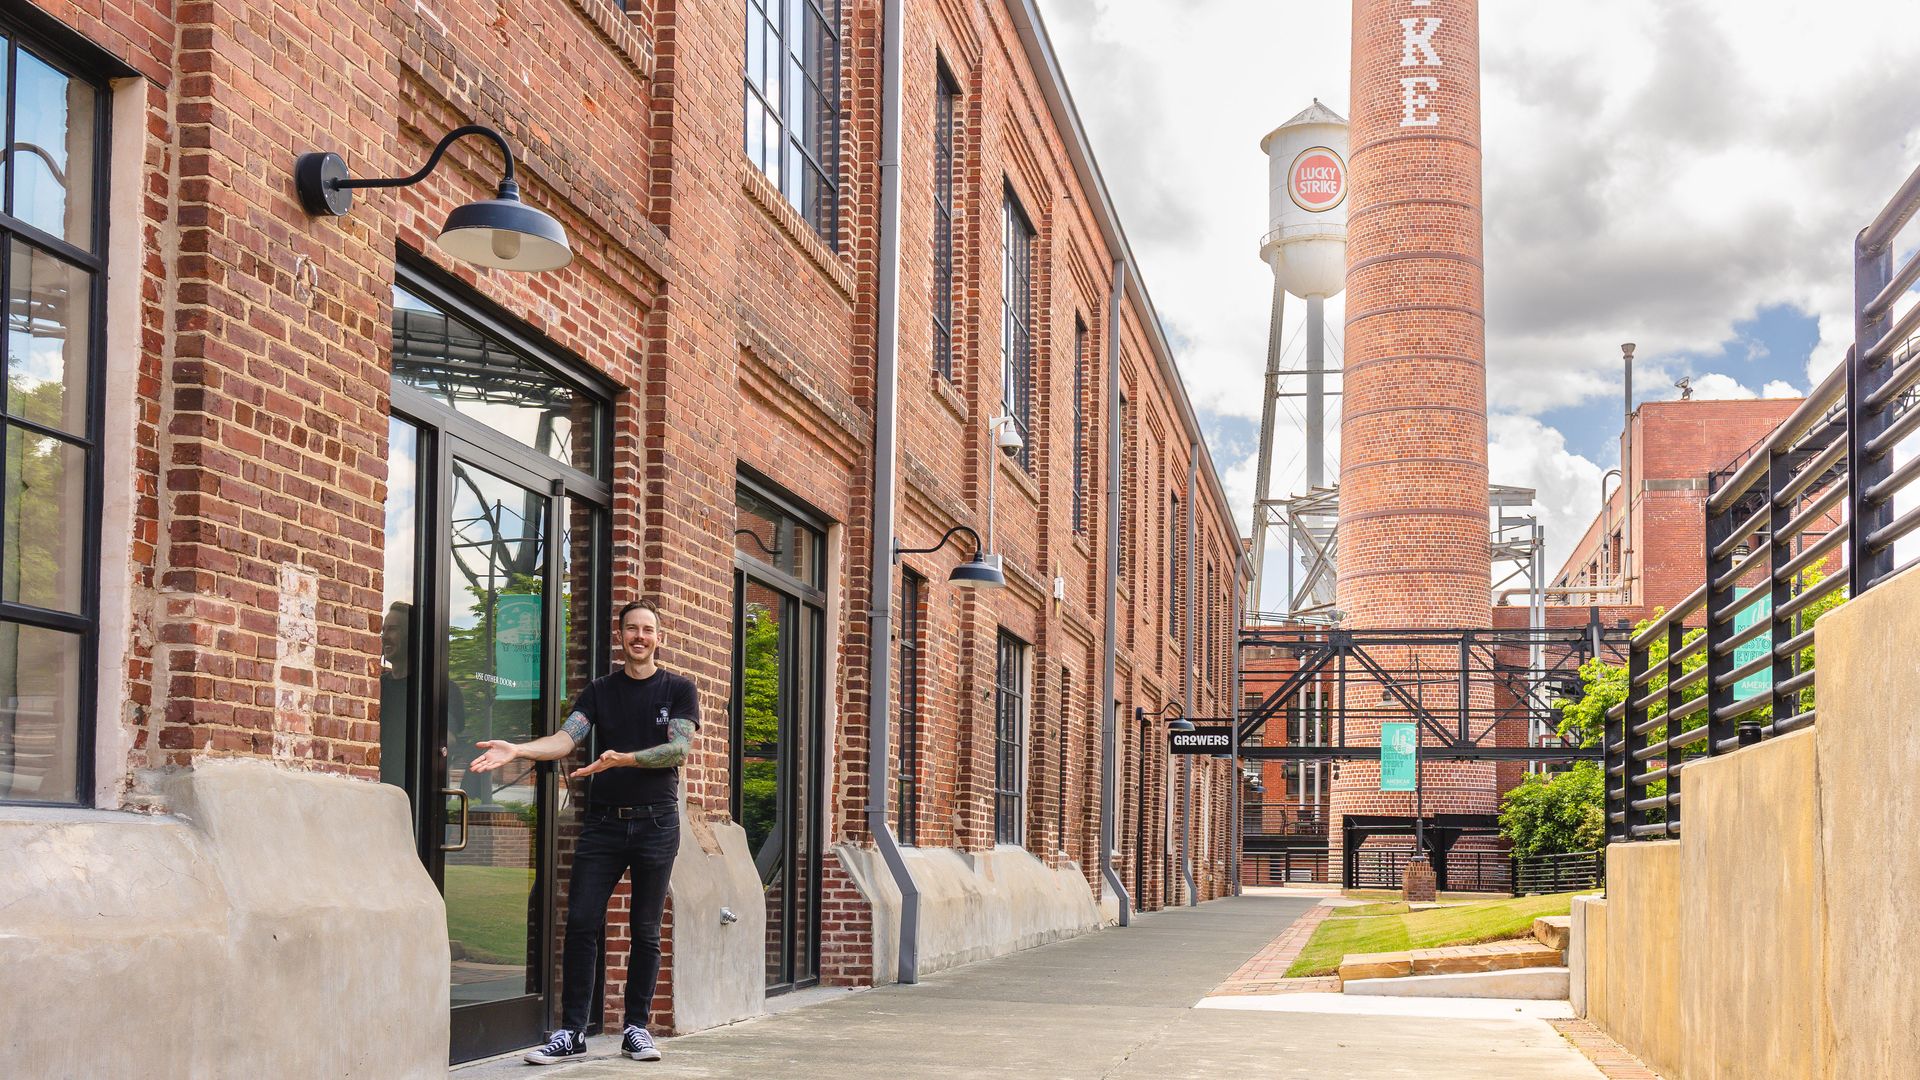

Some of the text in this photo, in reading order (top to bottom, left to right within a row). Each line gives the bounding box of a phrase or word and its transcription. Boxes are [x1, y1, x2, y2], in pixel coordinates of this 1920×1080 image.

[1301, 167, 1336, 180] LUCKY
[1300, 180, 1337, 194] STRIKE
[475, 671, 484, 681] USE
[484, 673, 499, 684] OTHER
[499, 677, 513, 688] DOOR
[1741, 681, 1771, 689] AMERIC
[1174, 735, 1229, 746] GROWERS
